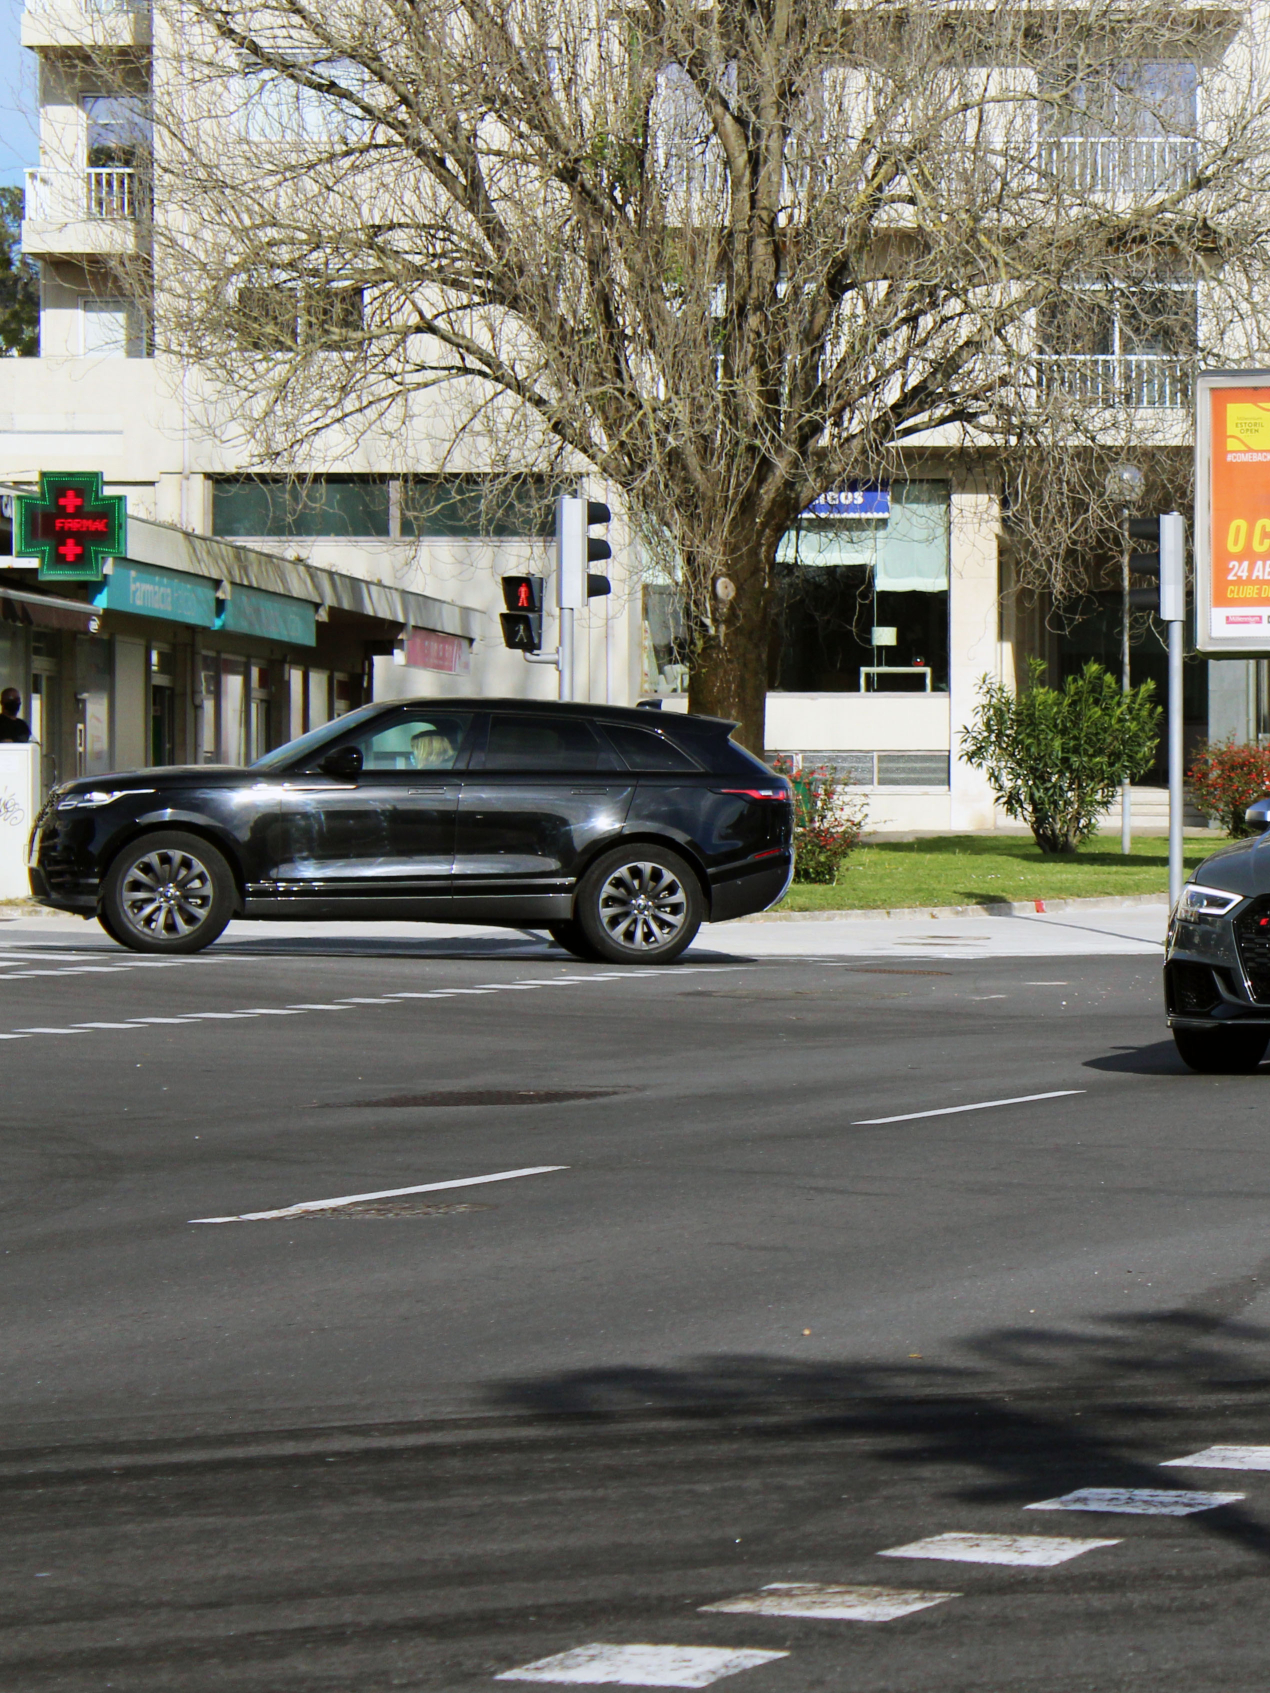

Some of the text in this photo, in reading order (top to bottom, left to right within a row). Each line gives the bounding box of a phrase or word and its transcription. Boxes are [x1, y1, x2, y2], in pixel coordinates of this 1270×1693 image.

[1227, 519, 1248, 553] O
[1227, 561, 1249, 580] 24
[1227, 585, 1259, 598] CLUBE
